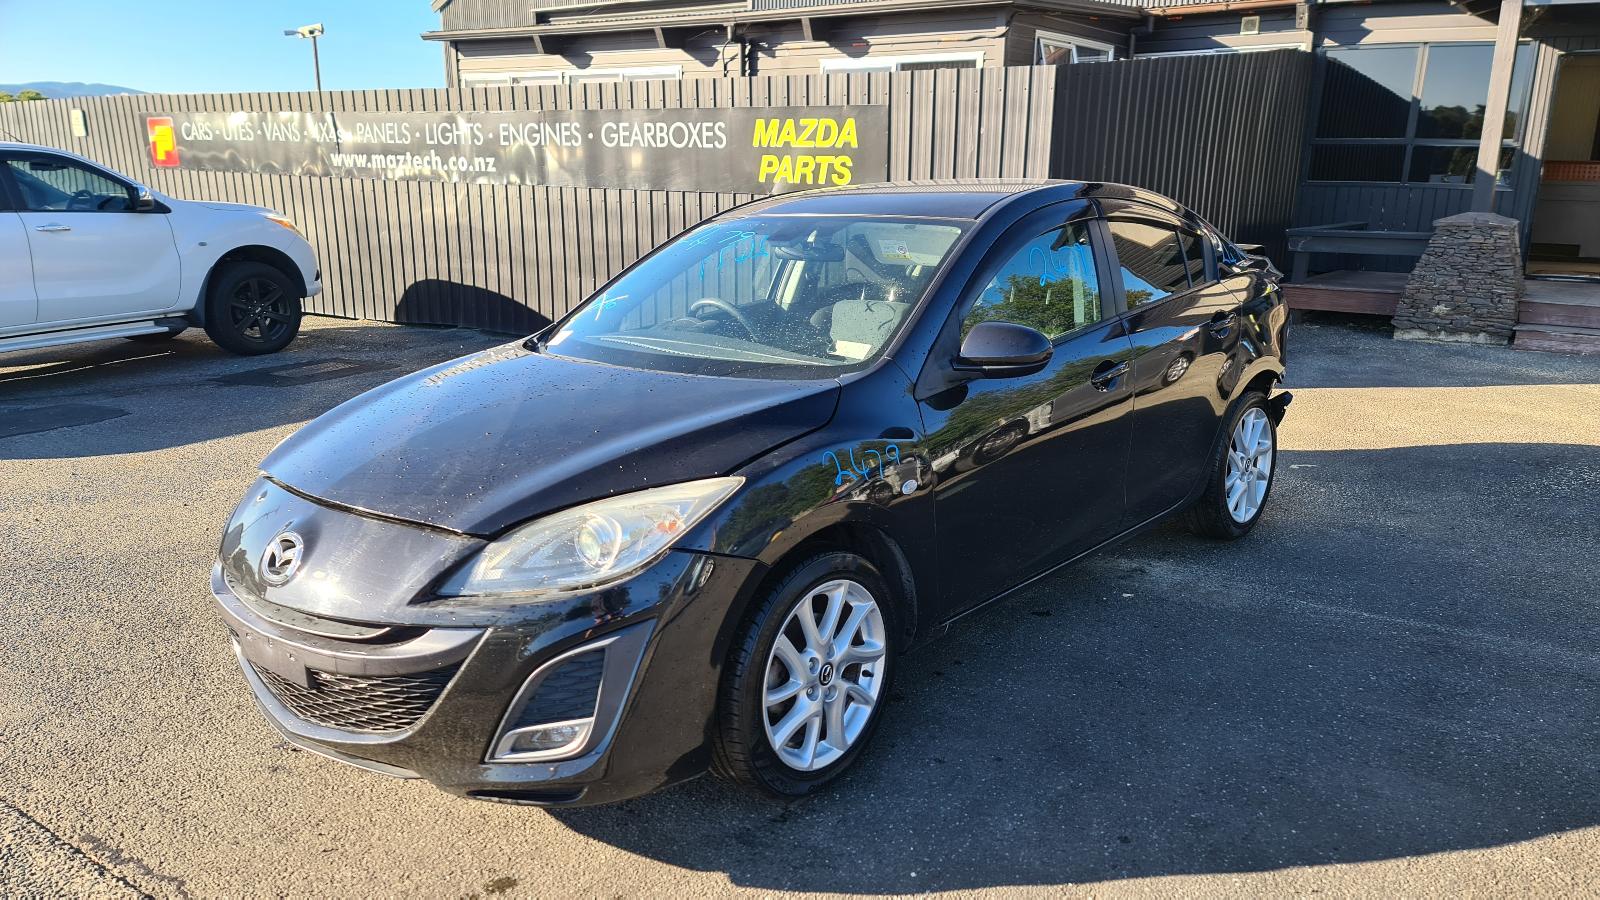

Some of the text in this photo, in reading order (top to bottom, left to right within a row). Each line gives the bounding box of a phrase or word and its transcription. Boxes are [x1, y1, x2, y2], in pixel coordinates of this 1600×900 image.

[181, 121, 213, 141] CARS
[222, 121, 254, 141] UTES
[261, 121, 301, 142] VANS
[356, 121, 412, 145] PANELS
[425, 122, 485, 146] LIGHTS
[499, 121, 582, 147] ENGINES
[600, 121, 728, 149] GEARBOXES
[752, 117, 860, 149] MAZDA
[330, 149, 497, 173] www.maztech.co.nz
[758, 154, 854, 187] PARTS
